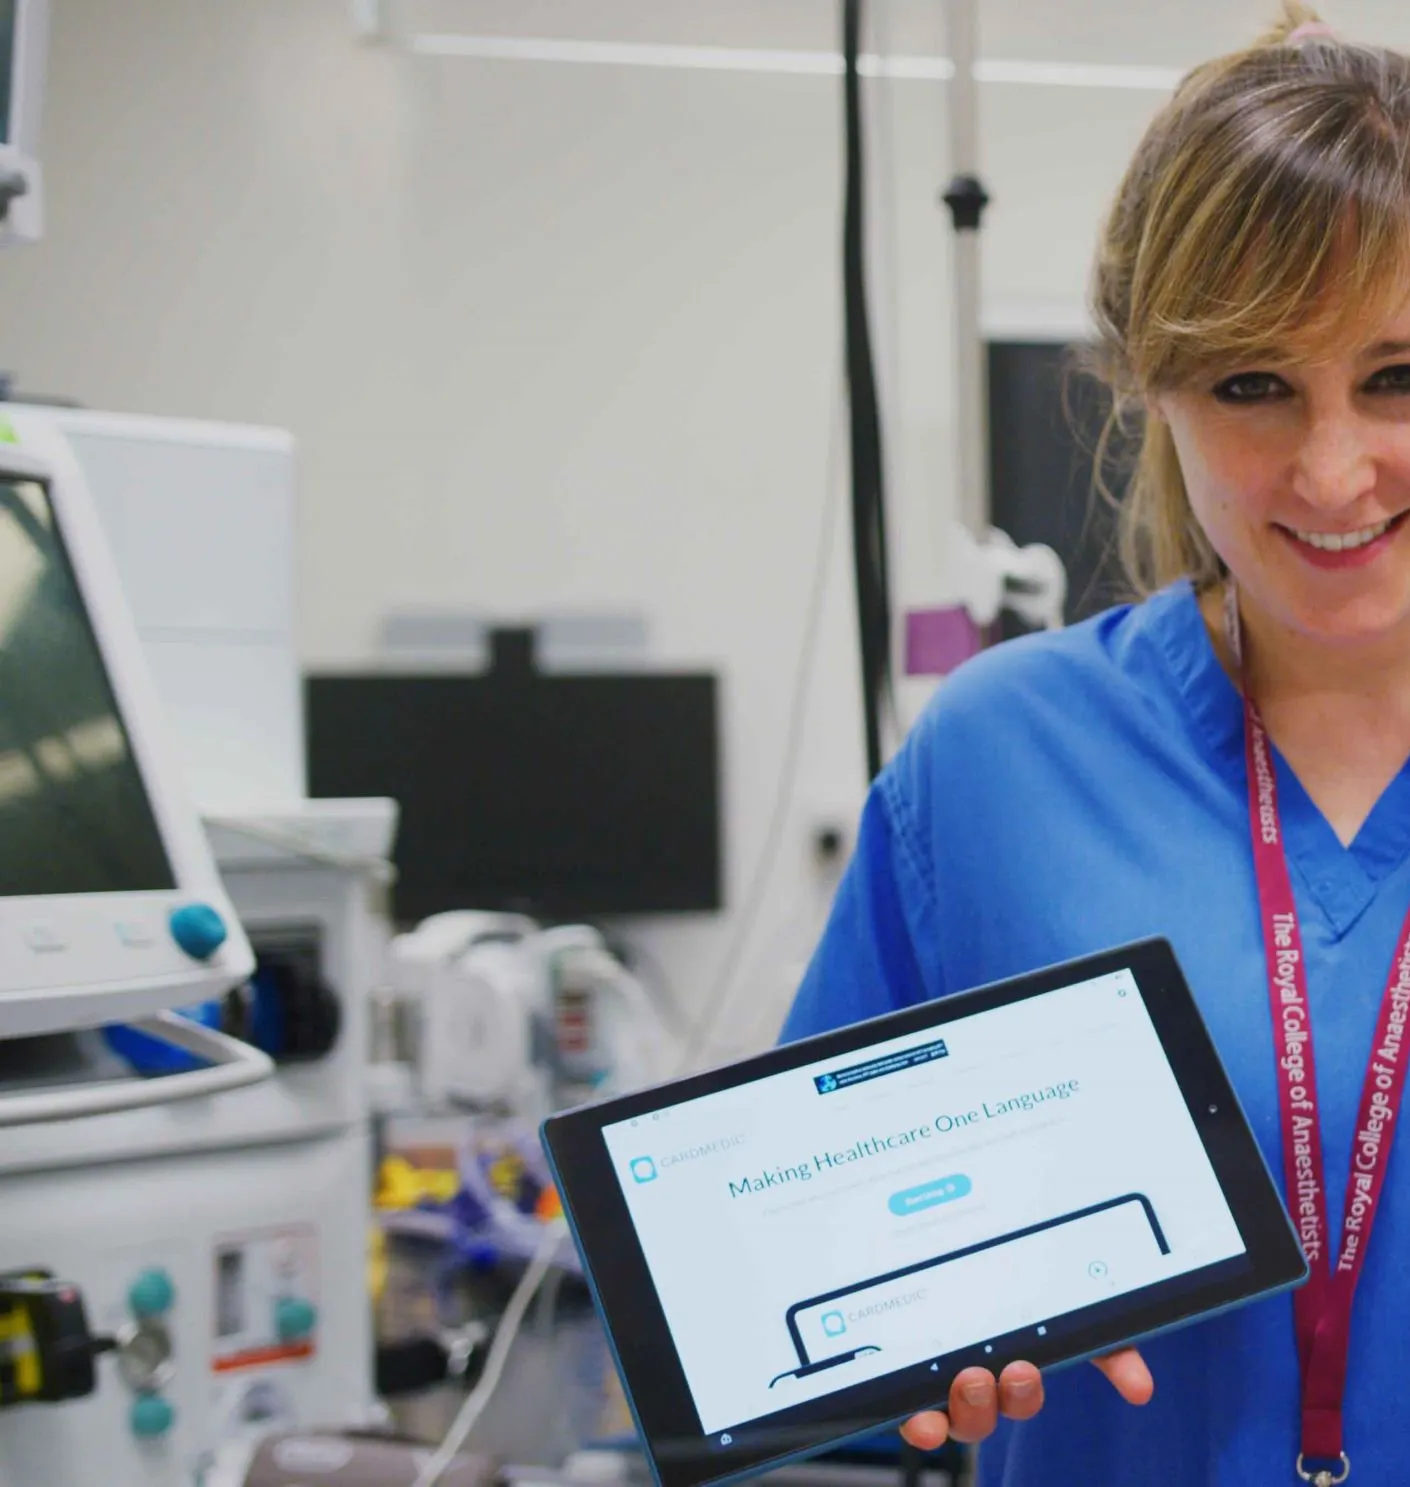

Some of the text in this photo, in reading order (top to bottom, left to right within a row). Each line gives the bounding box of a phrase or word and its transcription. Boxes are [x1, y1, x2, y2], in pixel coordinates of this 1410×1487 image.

[1272, 912, 1319, 1261] The Royal College of Anaesthetists
[1372, 1063, 1394, 1088] of
[728, 1163, 812, 1198] Making
[813, 1125, 931, 1171] Healthcare
[935, 1109, 980, 1132] One
[982, 1079, 1080, 1118] Language
[1355, 1091, 1392, 1170] College
[1346, 1173, 1373, 1235] Royal
[1337, 1241, 1359, 1271] The
